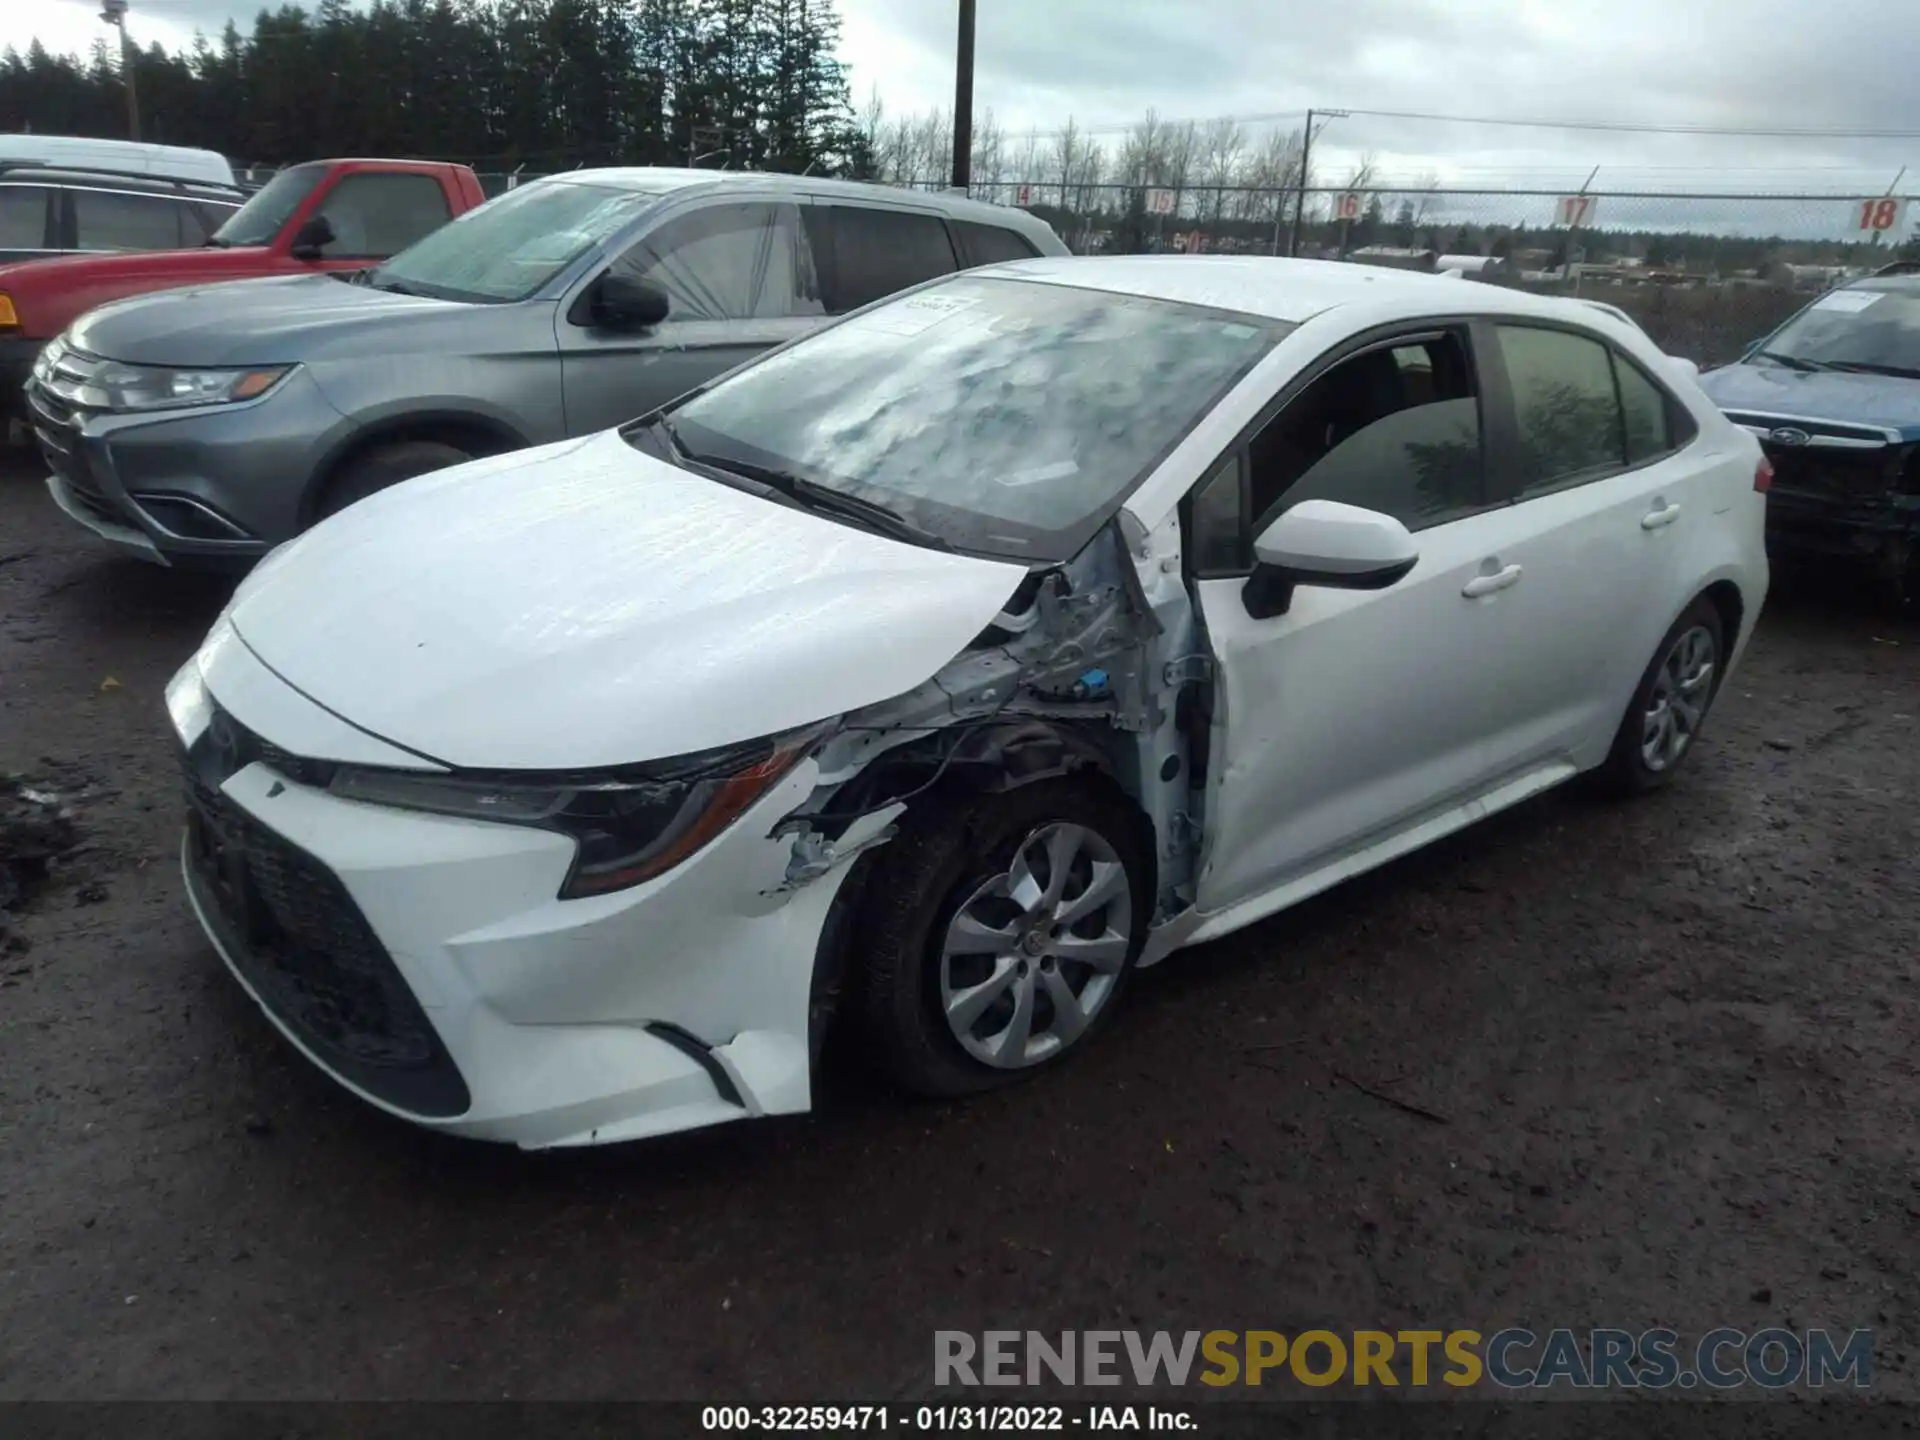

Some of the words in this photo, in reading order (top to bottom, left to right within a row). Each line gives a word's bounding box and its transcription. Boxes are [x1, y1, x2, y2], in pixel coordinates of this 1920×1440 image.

[1015, 186, 1029, 205] 14
[1337, 193, 1358, 217] 16
[1565, 197, 1588, 225] 17
[1860, 200, 1897, 230] 18
